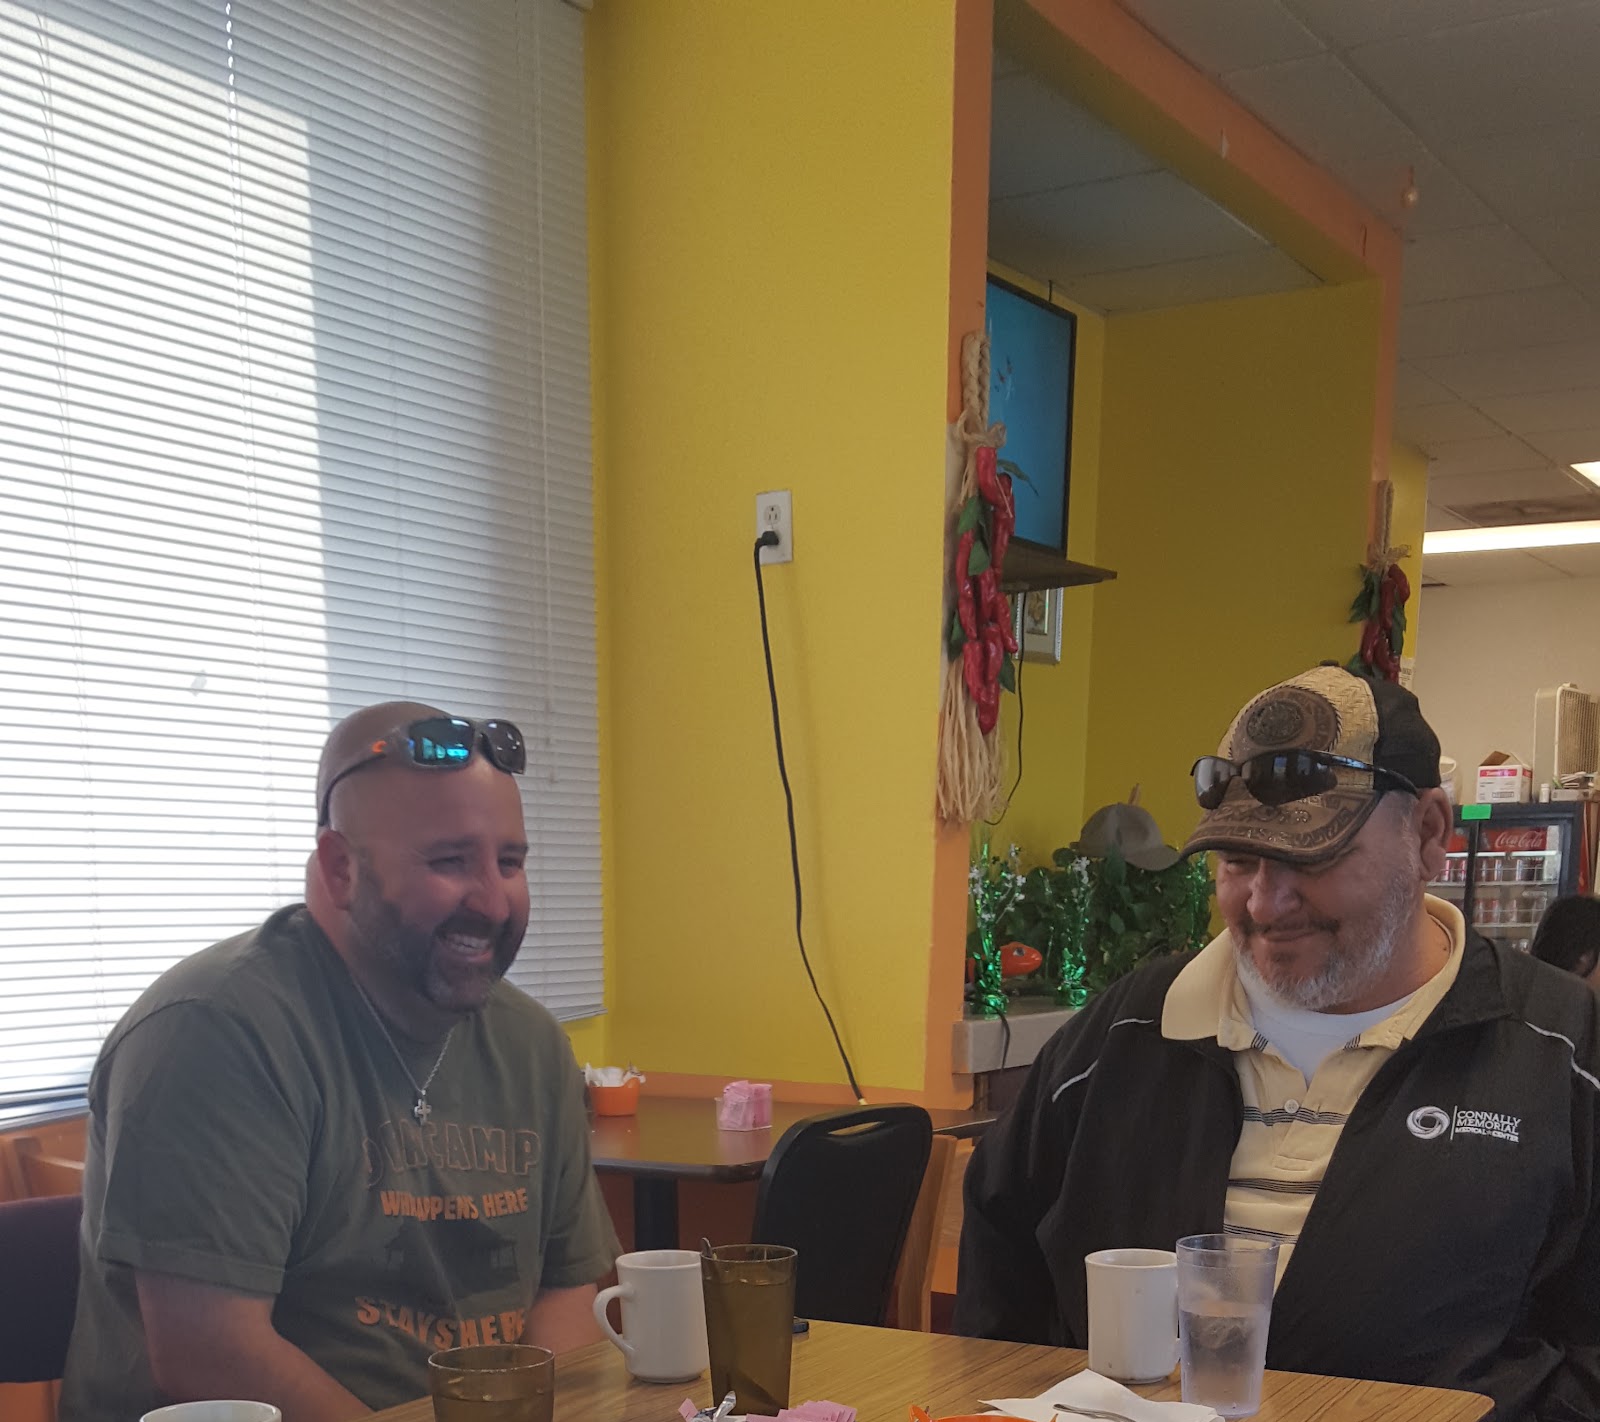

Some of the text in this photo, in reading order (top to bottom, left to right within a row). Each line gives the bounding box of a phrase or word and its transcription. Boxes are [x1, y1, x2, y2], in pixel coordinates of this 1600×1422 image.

[1456, 1119, 1519, 1135] MEMORIAL
[1457, 1111, 1521, 1127] CONNALLY
[1455, 1127, 1519, 1142] MEDICAL CENTER
[482, 1188, 528, 1217] HERE
[355, 1296, 455, 1350] STAYS
